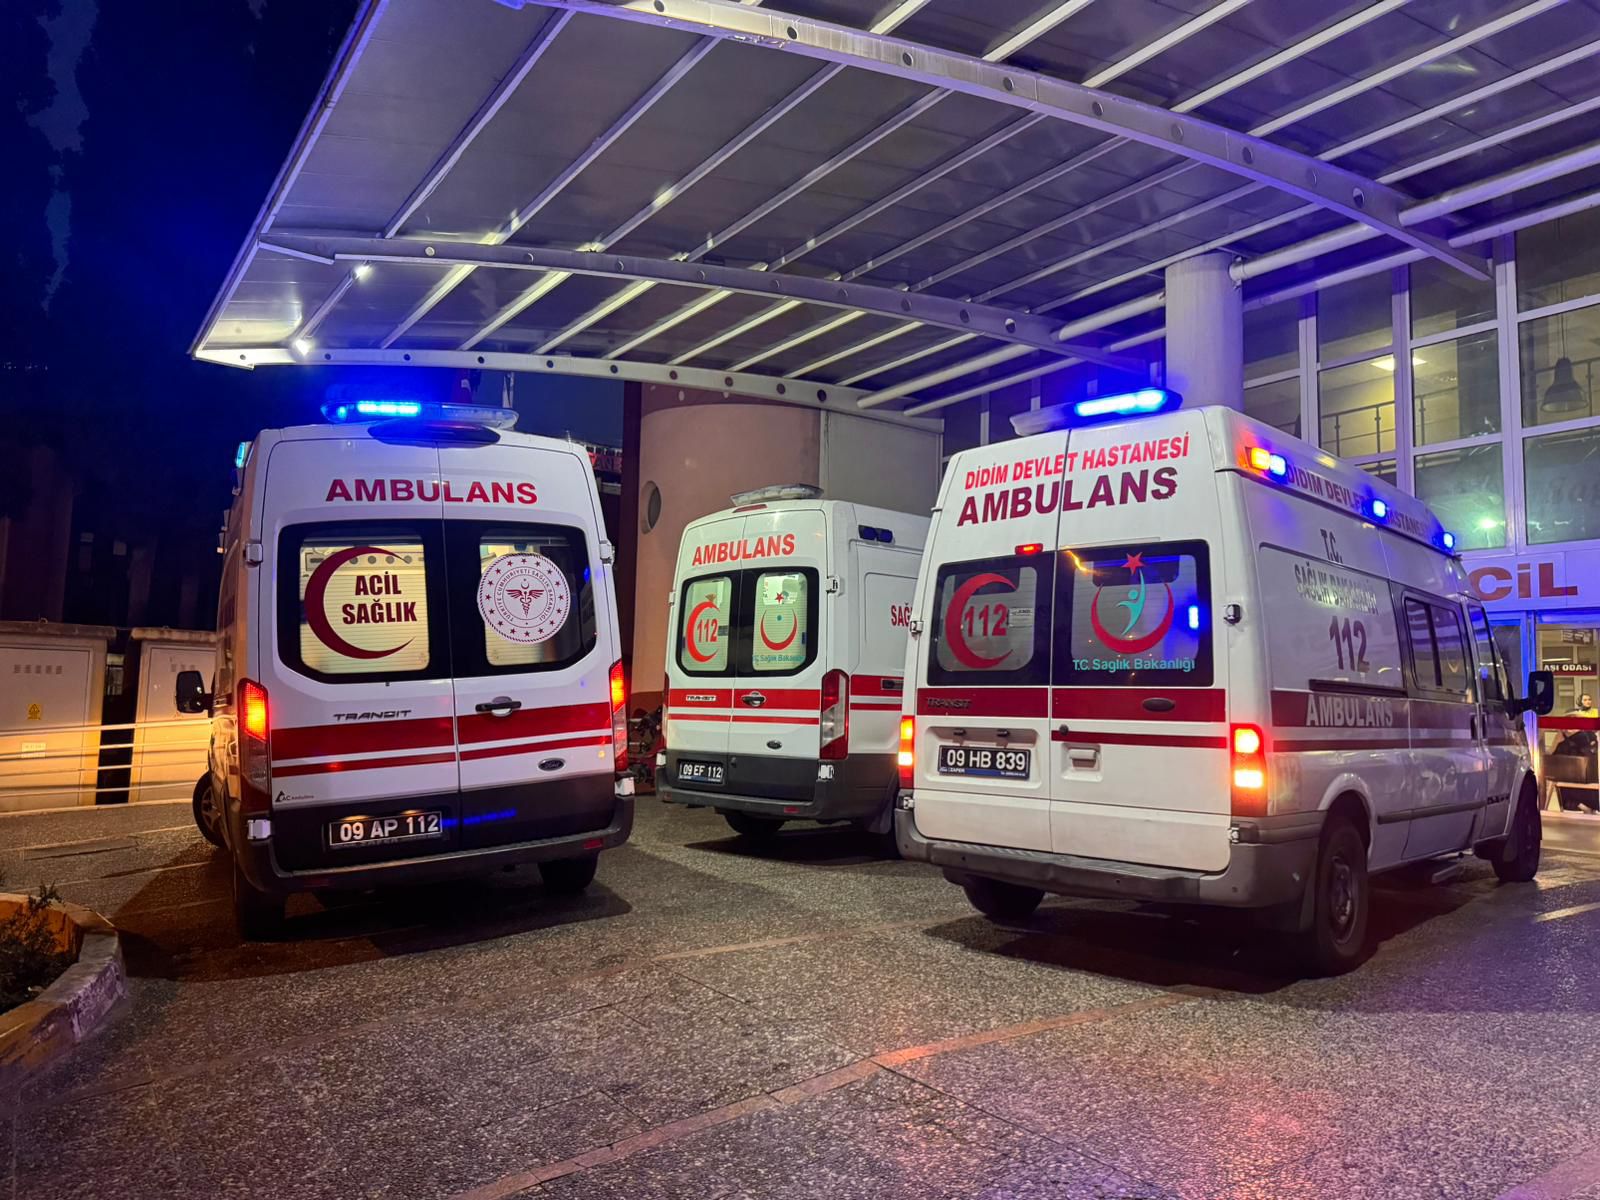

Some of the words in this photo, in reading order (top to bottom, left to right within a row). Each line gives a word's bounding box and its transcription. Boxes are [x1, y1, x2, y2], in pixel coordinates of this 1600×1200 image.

[965, 462, 1009, 490] DİDİM
[1013, 452, 1078, 481] DEVLET
[1082, 431, 1190, 470] HASTANESİ
[325, 479, 538, 504] AMBULANS
[957, 466, 1178, 527] AMBULANS
[692, 533, 795, 566] AMBULANS
[355, 571, 402, 595] ACİL
[342, 599, 418, 624] SAĞLIK
[891, 602, 912, 627] SAĞ
[965, 602, 1008, 637] 112
[697, 618, 719, 643] 112
[1329, 615, 1370, 673] 112
[1134, 657, 1195, 673] Bakanlığı
[333, 709, 412, 721] TRANSIT
[1306, 694, 1393, 727] AMBULANS
[683, 764, 692, 775] 09
[694, 764, 705, 776] EF
[707, 766, 721, 778] 112
[946, 749, 965, 766] 09
[969, 750, 991, 768] HB
[996, 752, 1025, 770] 839
[339, 822, 364, 841] 09
[370, 819, 398, 838] AP
[406, 815, 439, 834] 112
